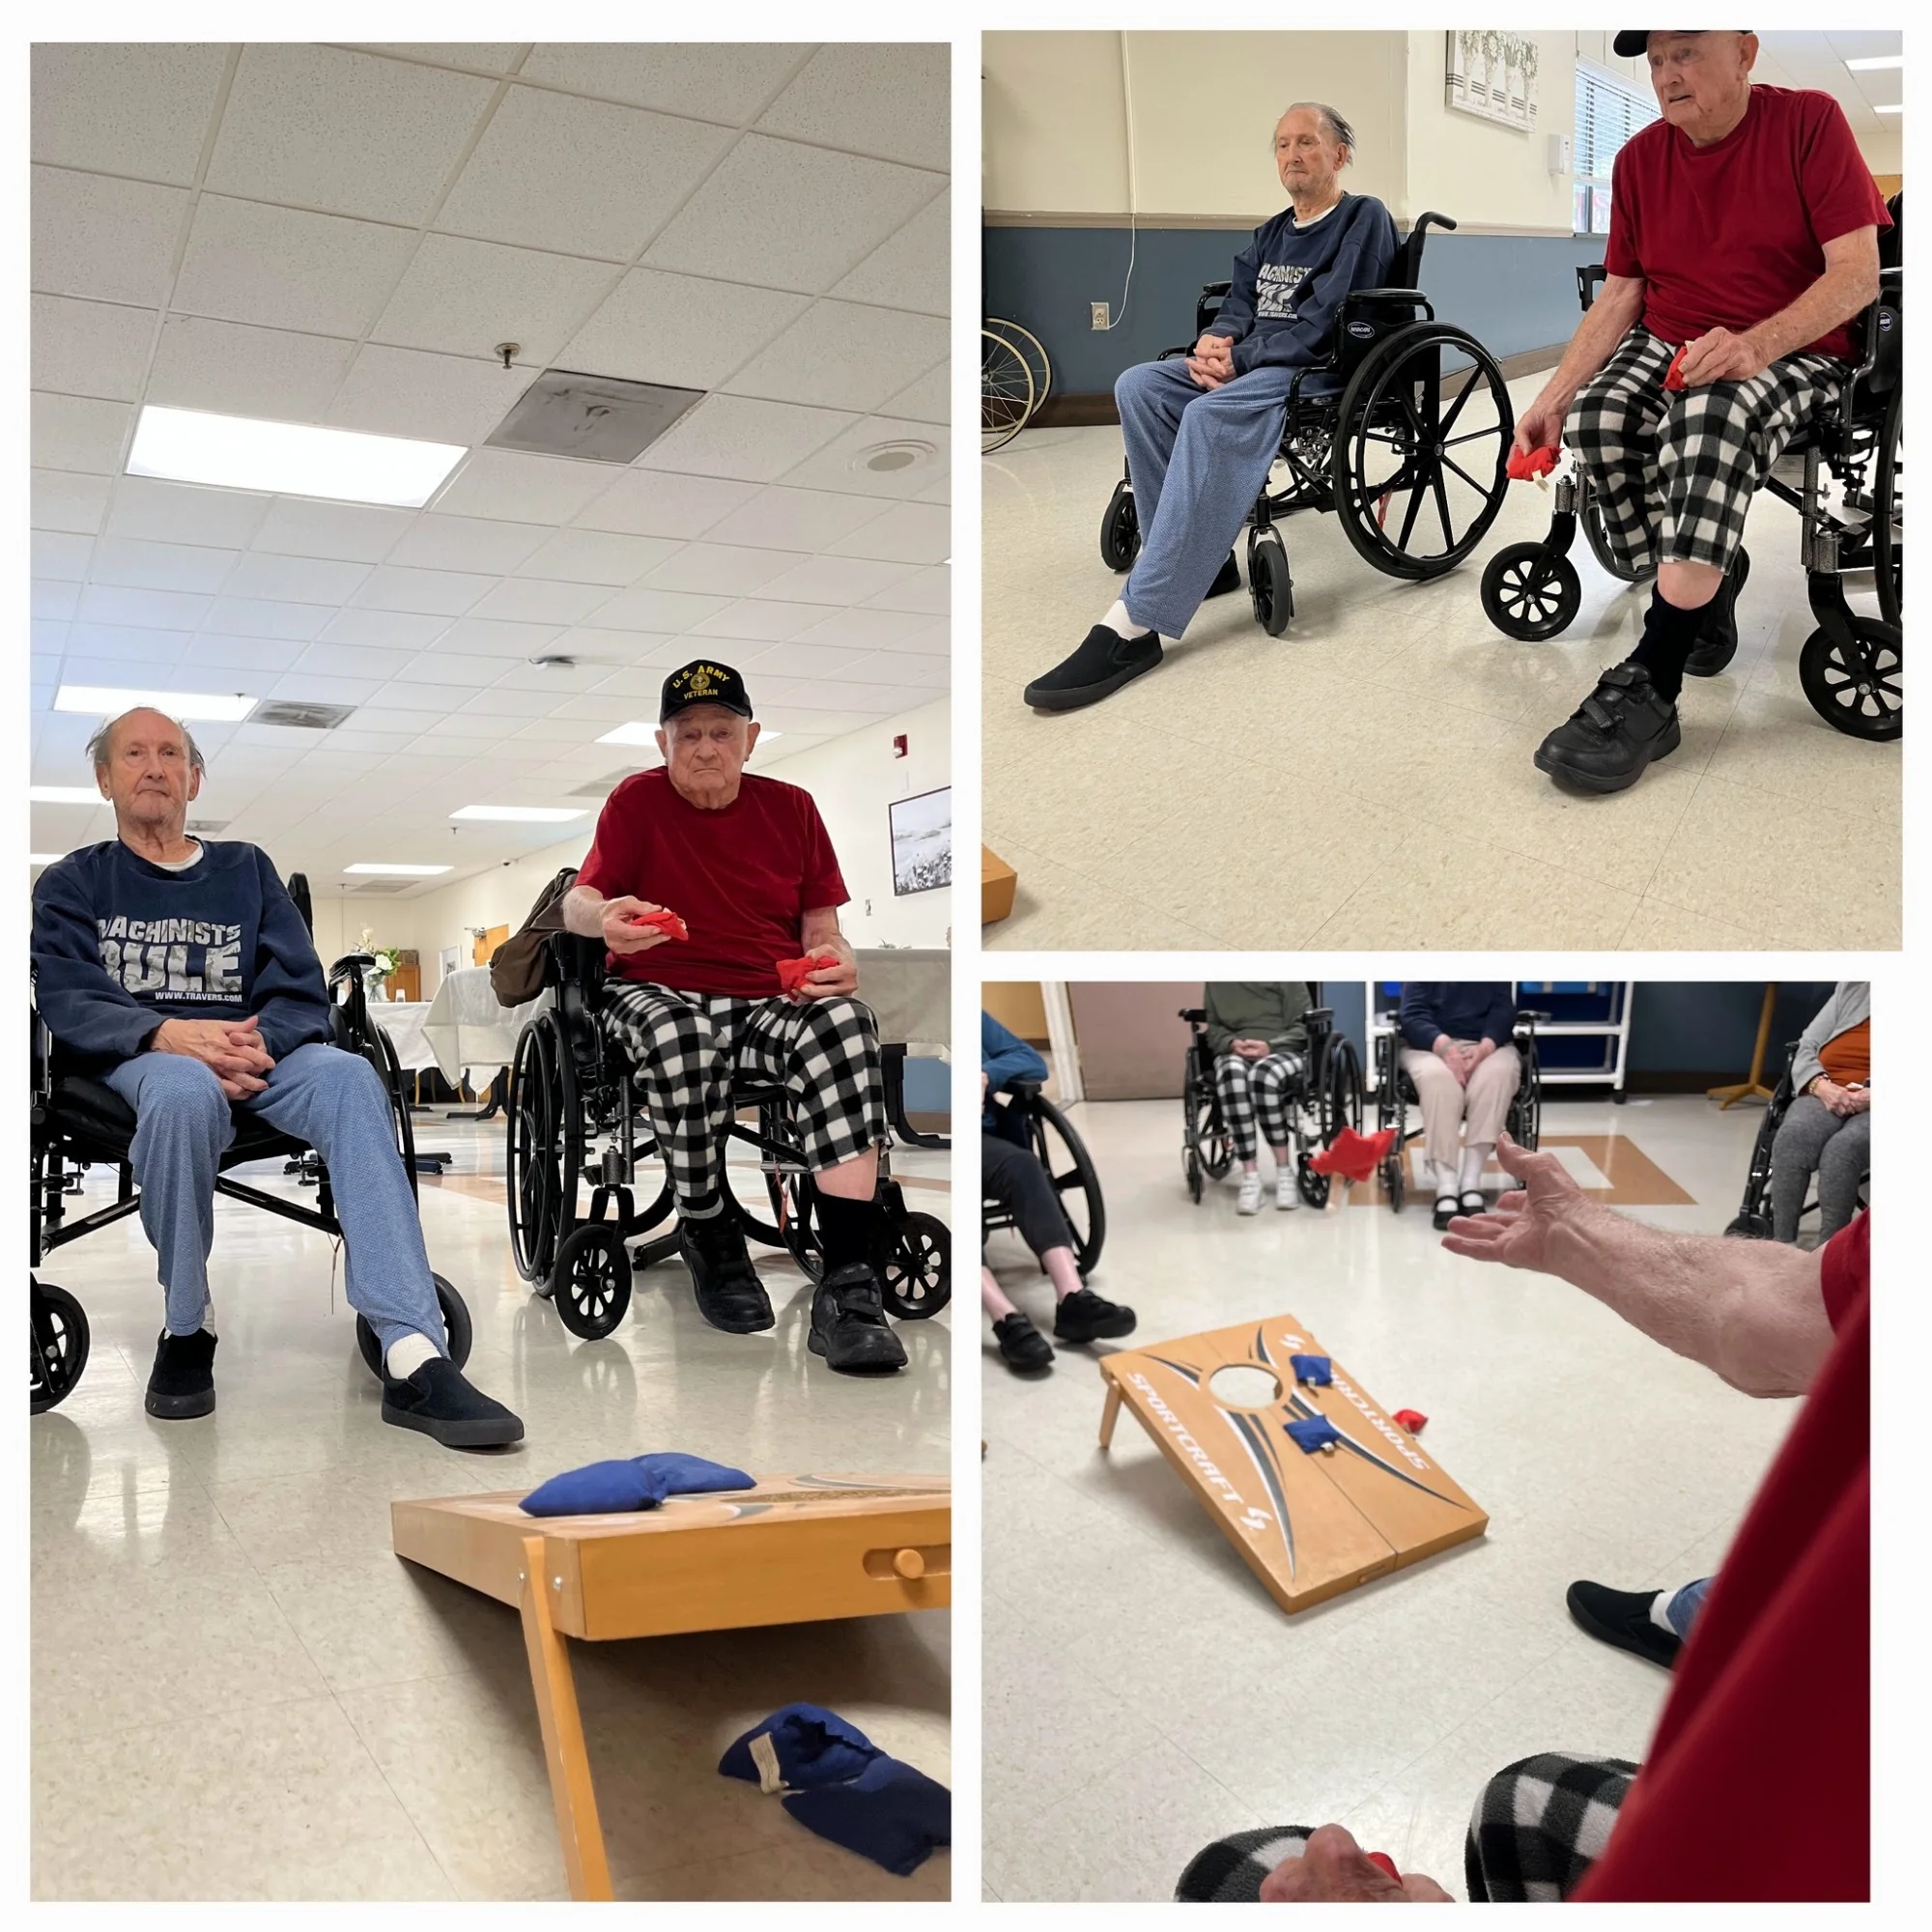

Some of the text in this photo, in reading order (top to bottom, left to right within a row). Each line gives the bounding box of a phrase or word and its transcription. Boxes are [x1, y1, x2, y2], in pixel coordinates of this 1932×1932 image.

[672, 665, 730, 689] U.S. ARMY
[683, 689, 719, 700] VETERAN
[155, 991, 242, 1003] WWW.TRAVERS.COM
[1330, 1368, 1431, 1470] SPORTCRA
[1126, 1372, 1244, 1504] SPORTCRAFT
